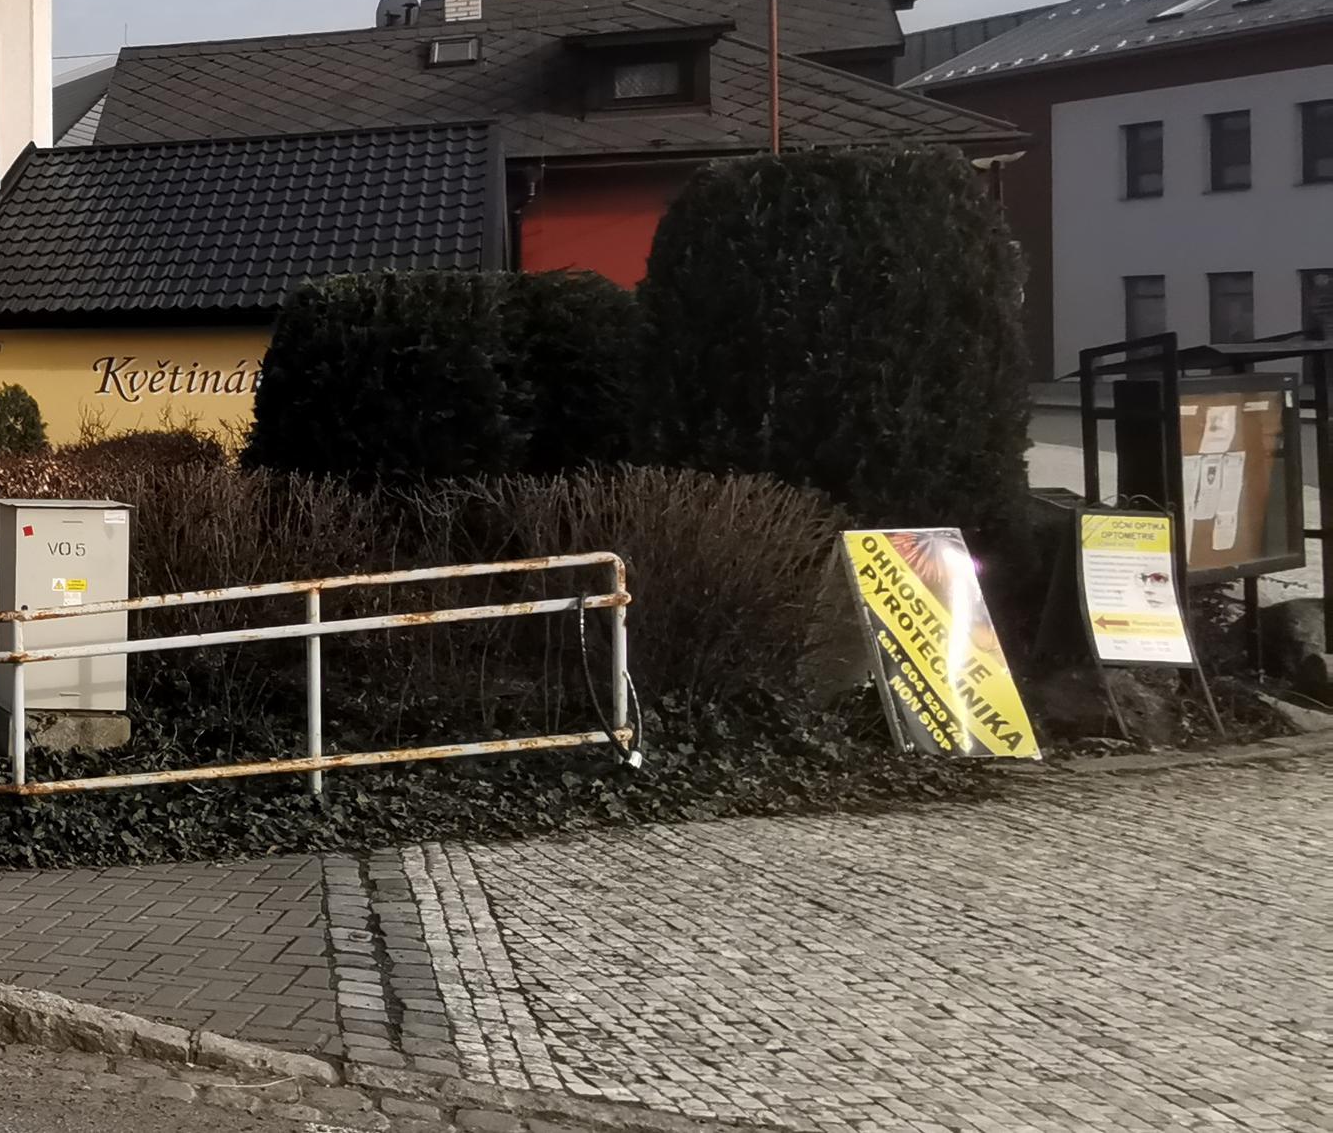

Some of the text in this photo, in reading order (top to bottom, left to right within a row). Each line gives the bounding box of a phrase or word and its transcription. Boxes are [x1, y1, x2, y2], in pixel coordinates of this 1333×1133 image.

[1134, 521, 1167, 531] OPTIKA
[75, 543, 86, 557] 5
[901, 662, 925, 692] 604
[924, 692, 947, 722] 520
[889, 675, 952, 751] NON STOP
